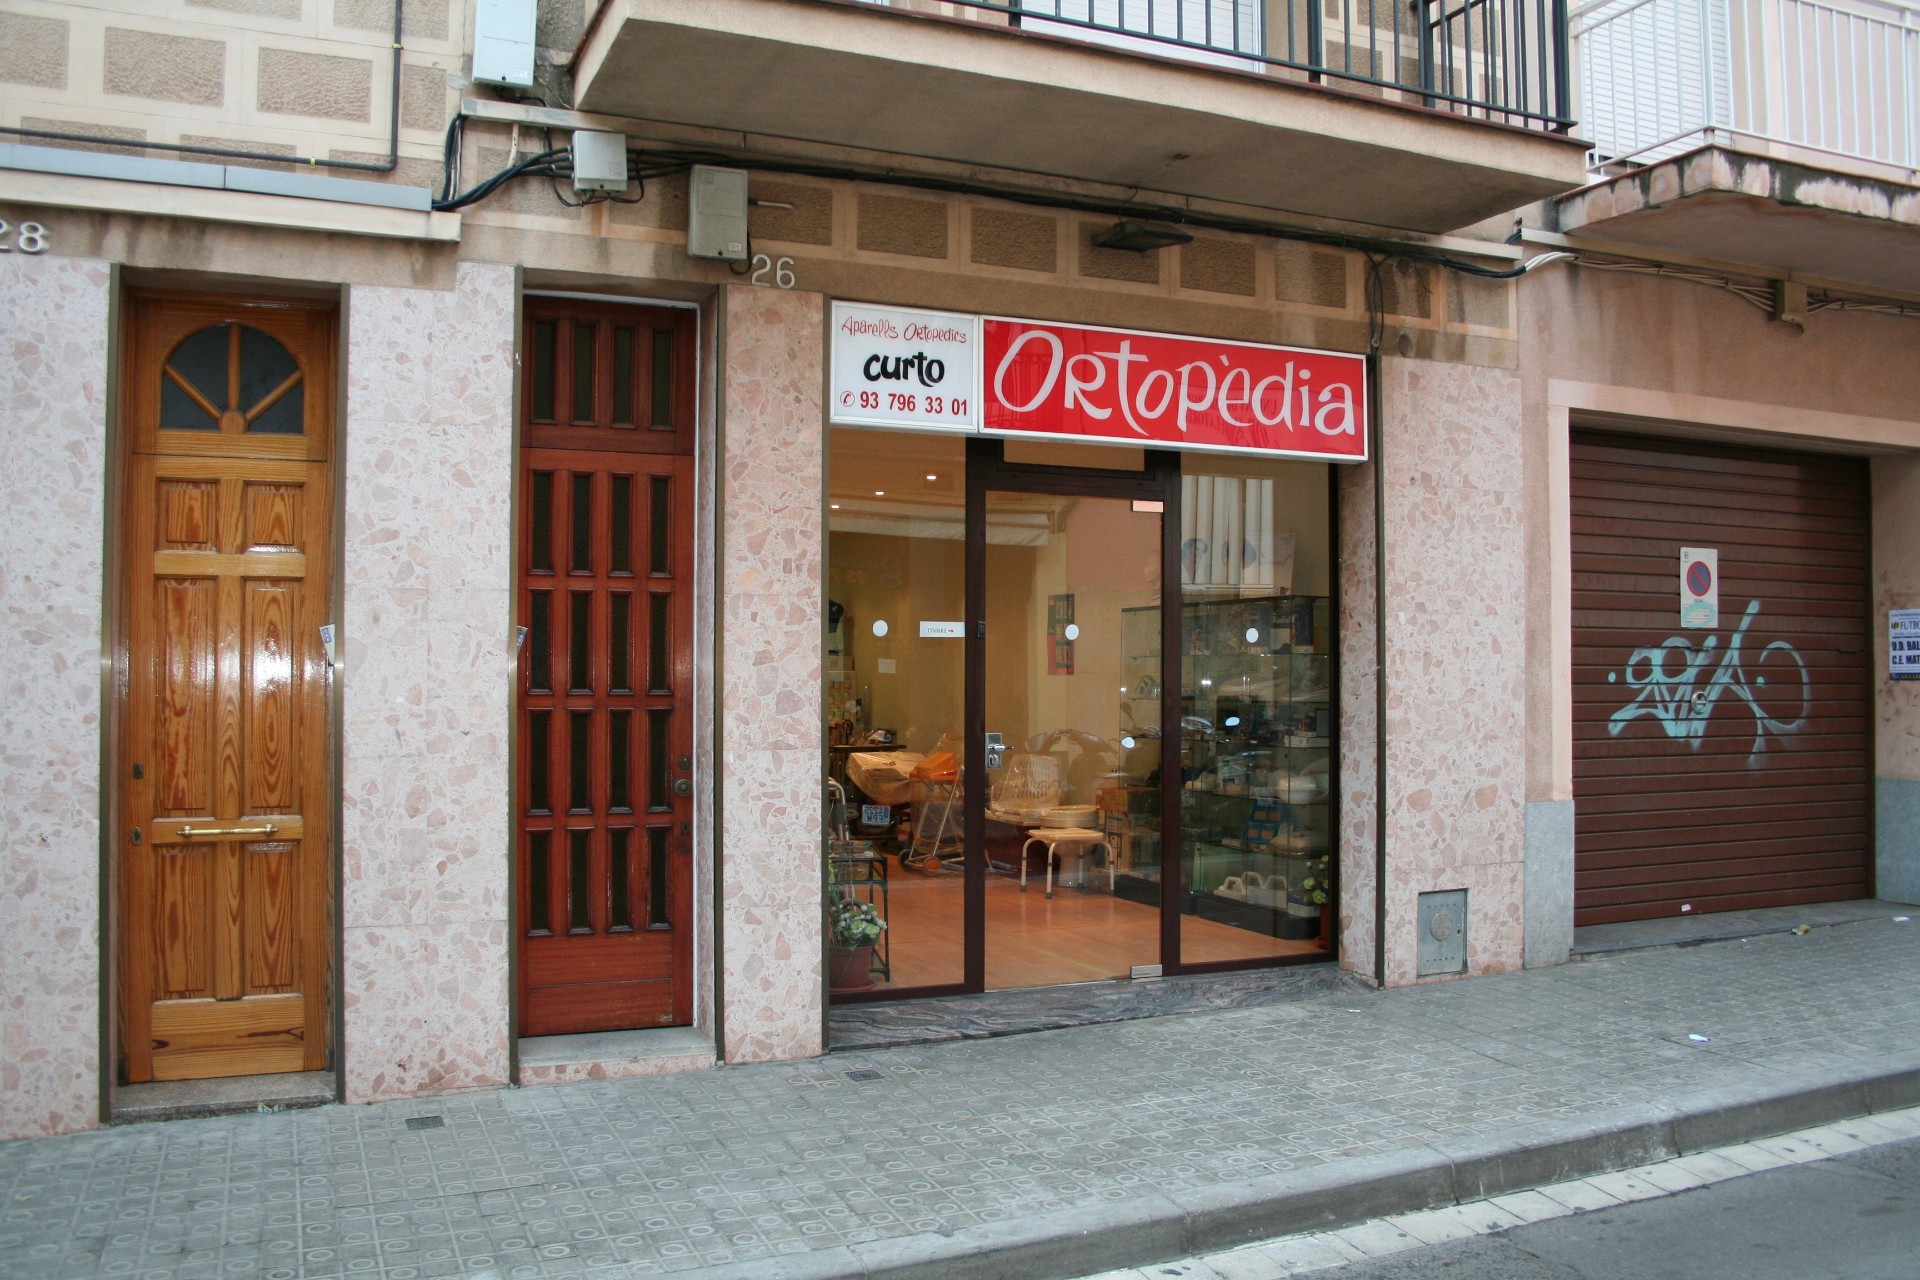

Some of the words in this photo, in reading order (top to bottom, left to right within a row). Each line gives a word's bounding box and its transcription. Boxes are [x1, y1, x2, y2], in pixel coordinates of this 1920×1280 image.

[752, 254, 795, 289] 26
[841, 316, 898, 339] Aparells
[863, 352, 945, 387] curto
[860, 391, 878, 409] 93
[888, 393, 916, 411] 796
[925, 396, 943, 414] 33
[951, 398, 967, 416] 01
